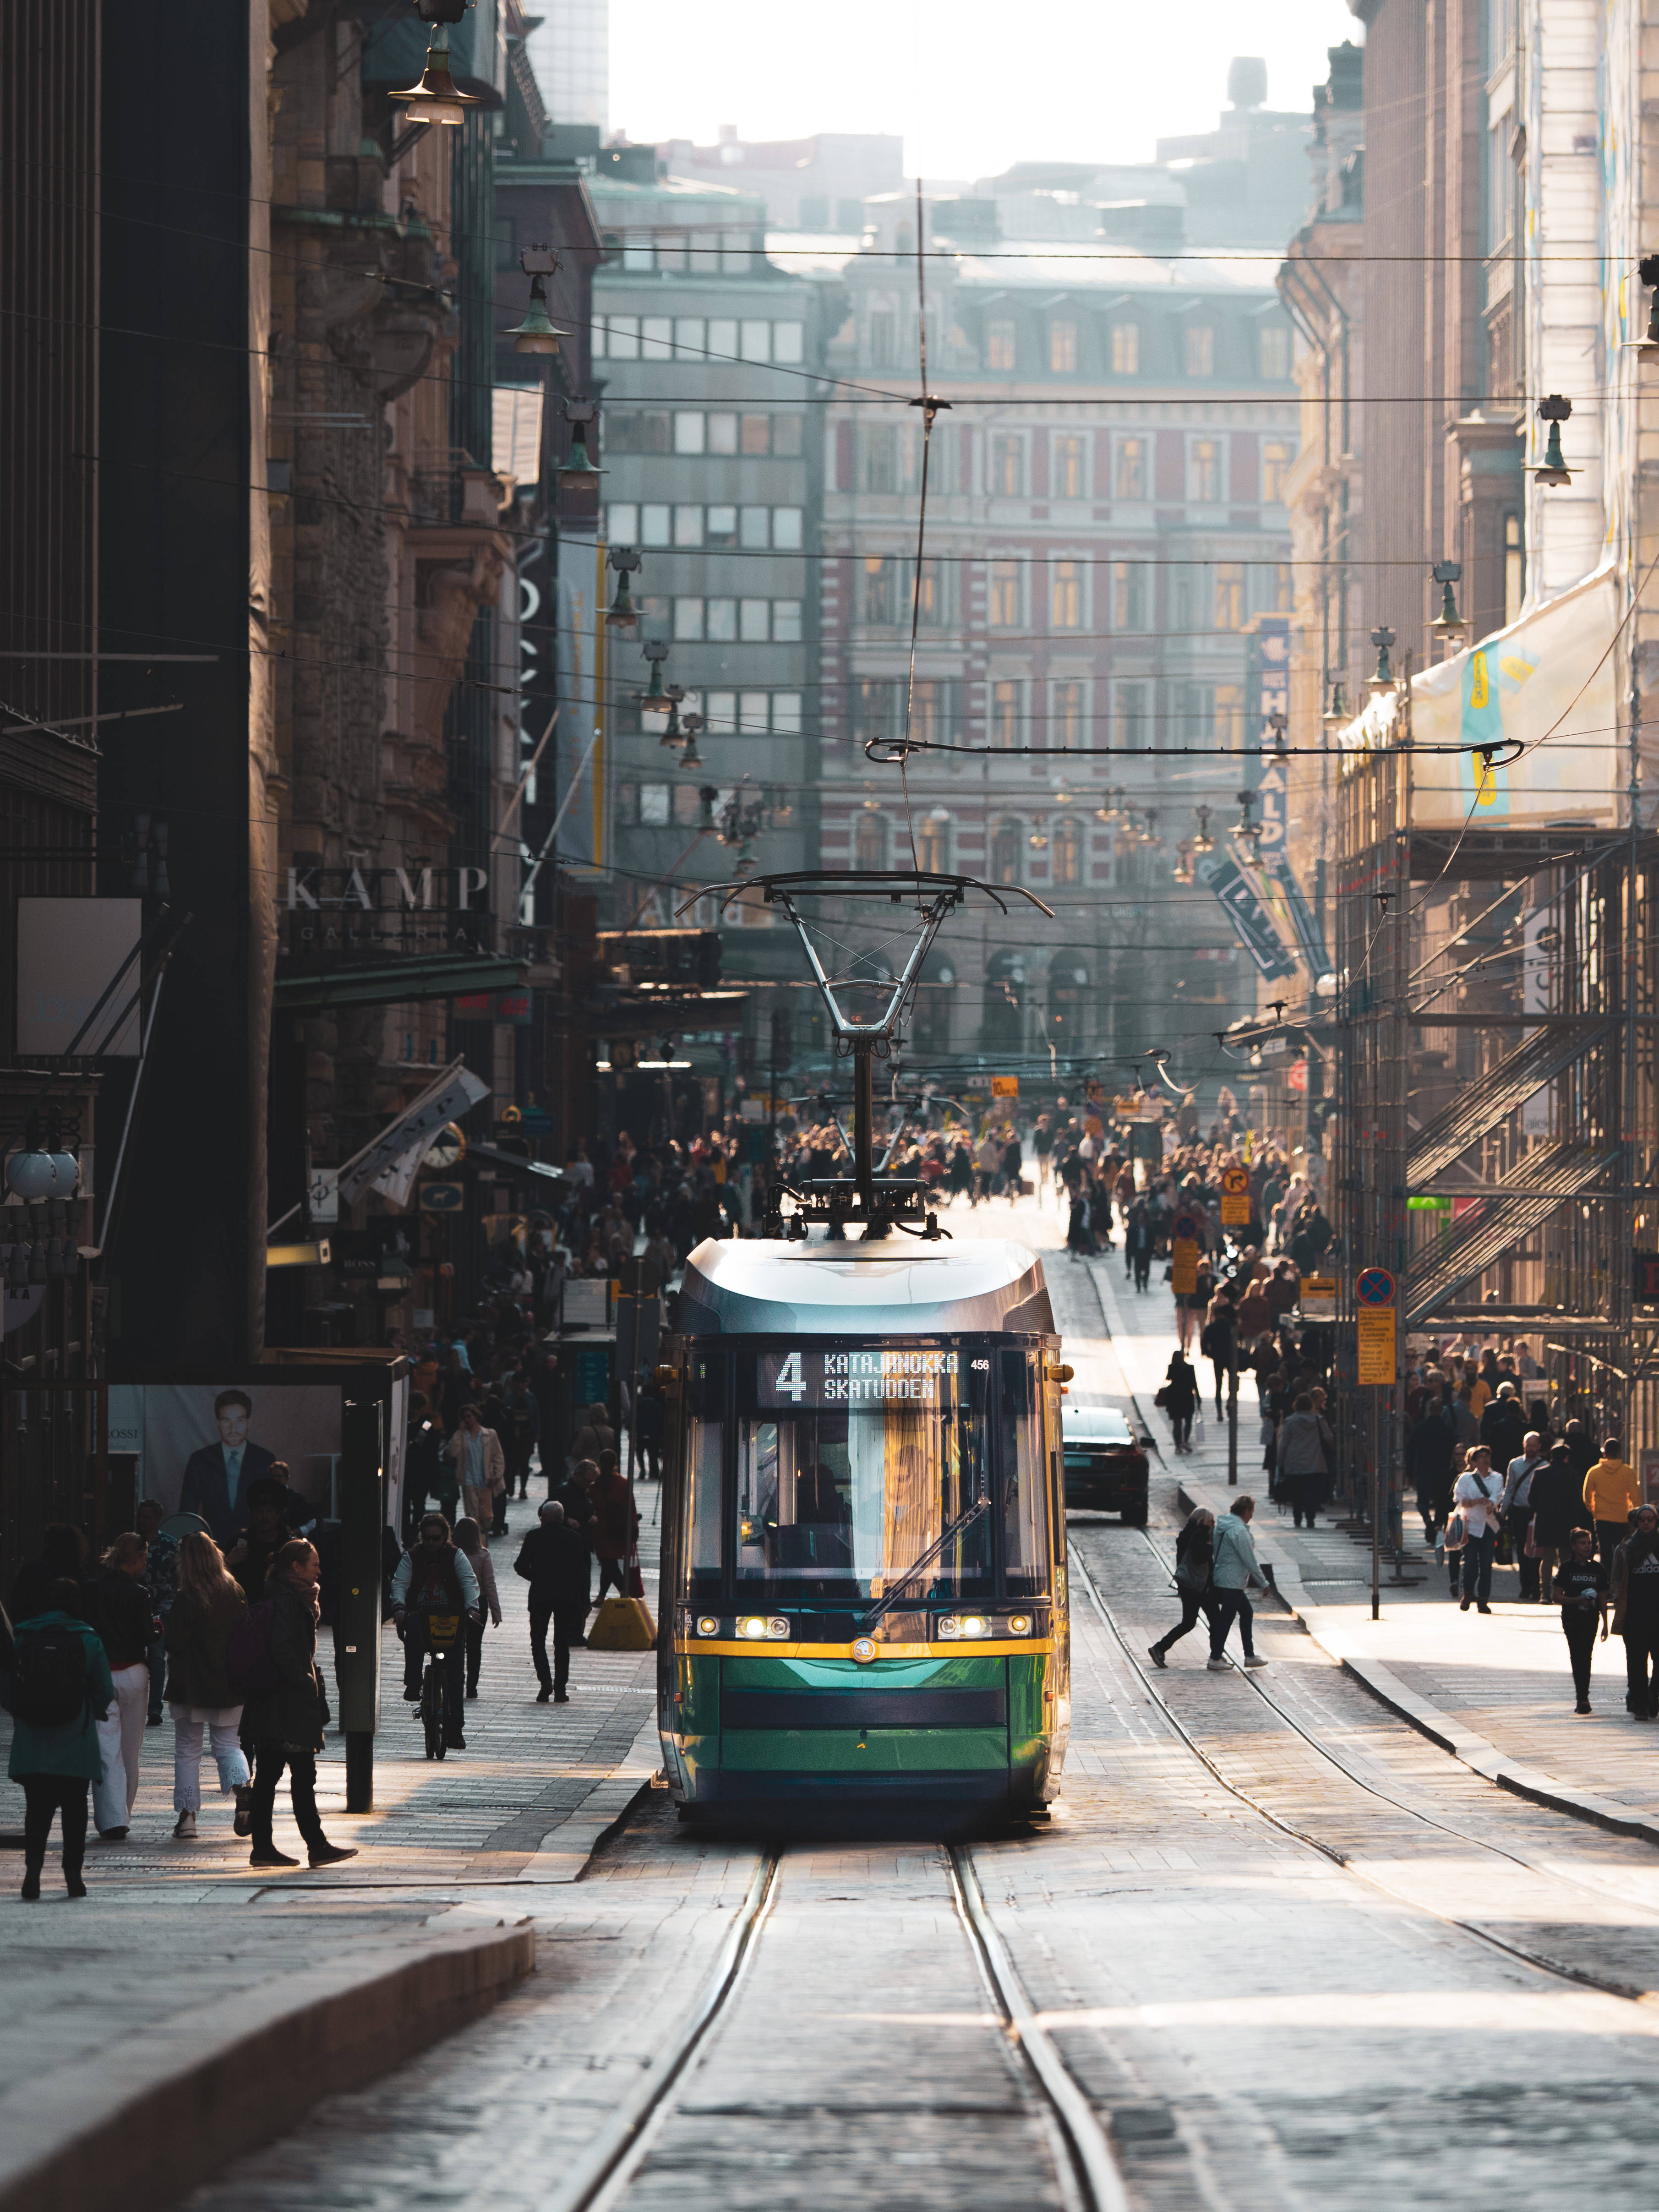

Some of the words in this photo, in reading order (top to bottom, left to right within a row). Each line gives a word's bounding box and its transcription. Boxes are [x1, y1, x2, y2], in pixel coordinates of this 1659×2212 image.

[824, 1354, 959, 1374] KATAJANOKKA
[971, 1359, 989, 1371] 456
[775, 1352, 807, 1401] 4
[824, 1379, 934, 1399] SKATUDDEN
[1572, 1575, 1597, 1583] ADIDAS
